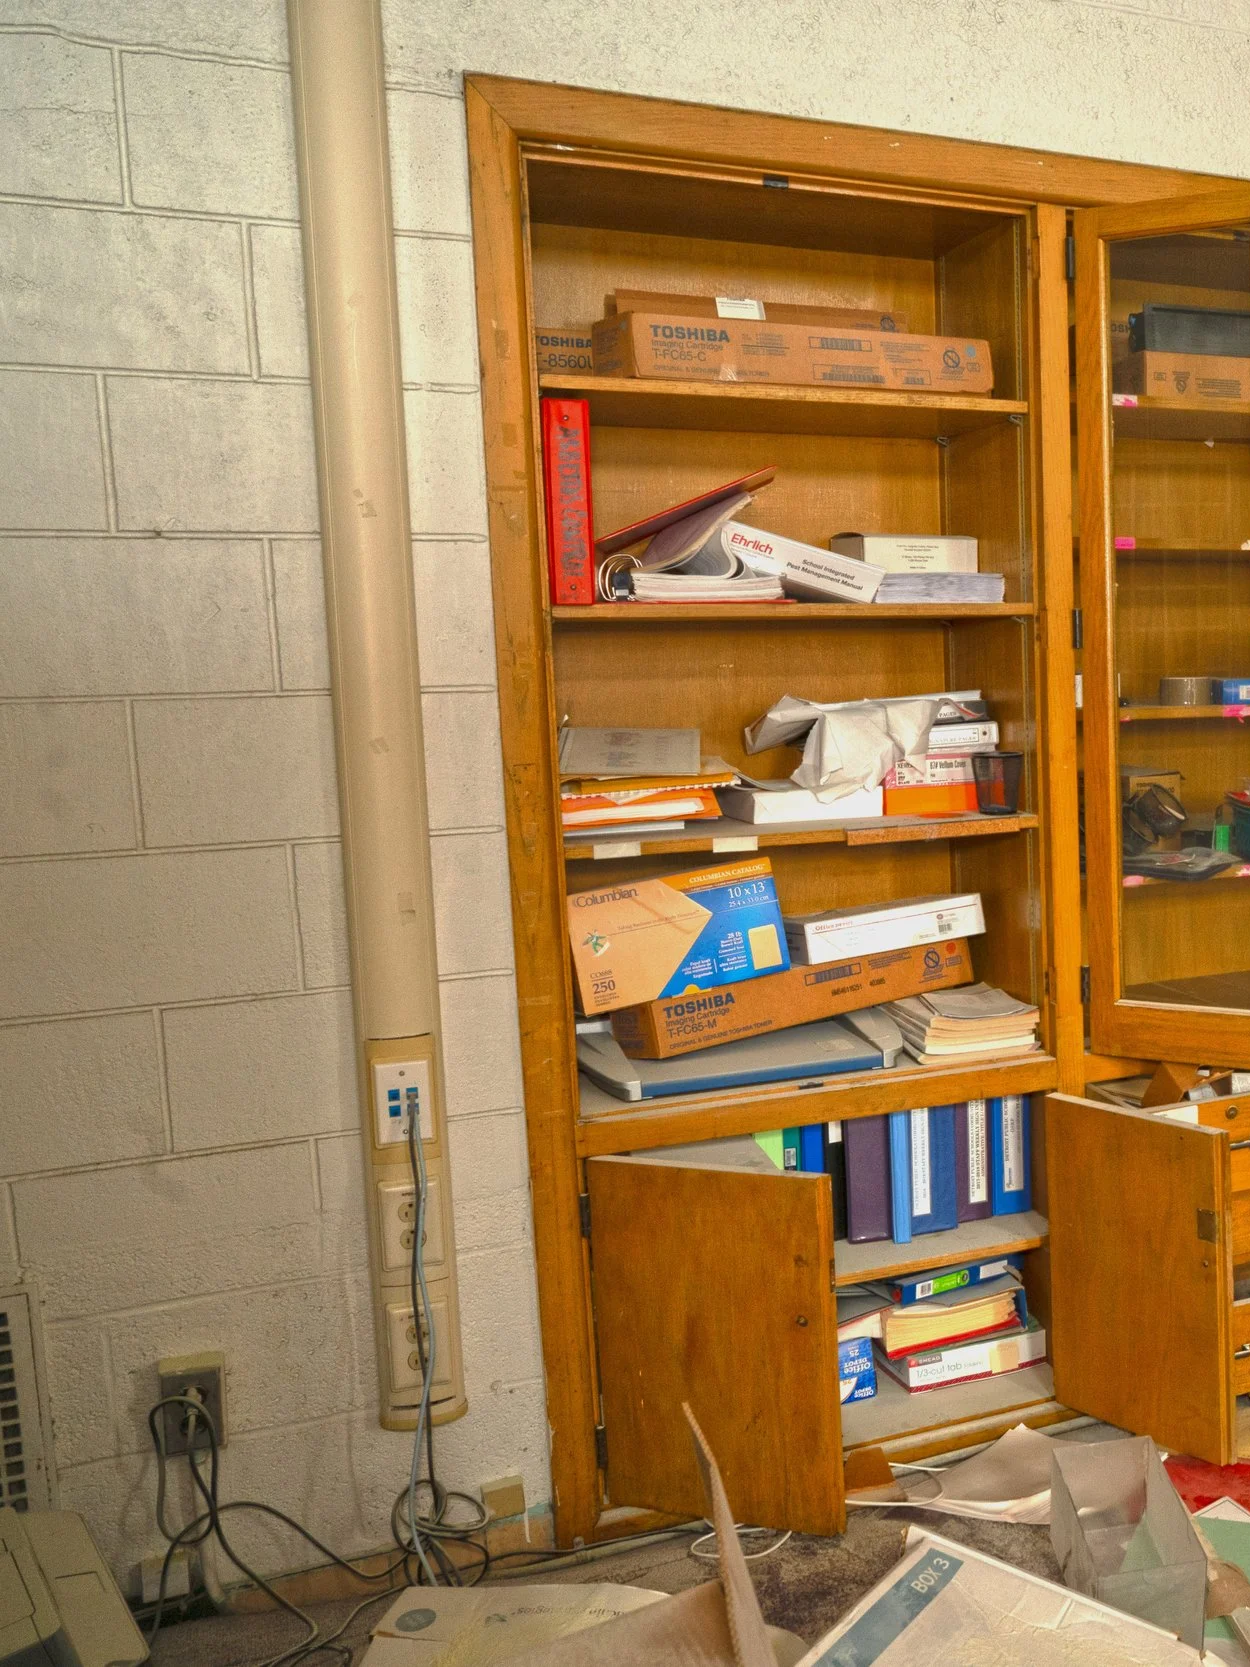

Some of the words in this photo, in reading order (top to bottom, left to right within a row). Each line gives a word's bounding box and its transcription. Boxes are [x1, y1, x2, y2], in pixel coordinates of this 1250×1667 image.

[650, 324, 730, 343] TOSHIBA
[731, 533, 773, 555] Ehrlich
[786, 561, 801, 571] Pest
[801, 567, 841, 584] Management
[841, 579, 863, 591] Manual
[802, 559, 823, 570] School
[824, 565, 855, 581] Integrated
[689, 868, 730, 884] COLUMBIAN
[575, 887, 638, 908] Columbian
[592, 980, 616, 995] 250
[663, 992, 735, 1018] TOSHIBA
[665, 1016, 696, 1028] Imaging
[696, 1008, 731, 1023] Cartridge
[667, 1018, 717, 1039] T-FC65-M
[849, 1349, 860, 1357] 25
[919, 1355, 941, 1364] SMEAD
[843, 1360, 871, 1375] Office
[916, 1365, 946, 1378] 1/3-cut
[947, 1362, 963, 1371] tab
[910, 1566, 942, 1594] BOX
[933, 1557, 949, 1570] 3
